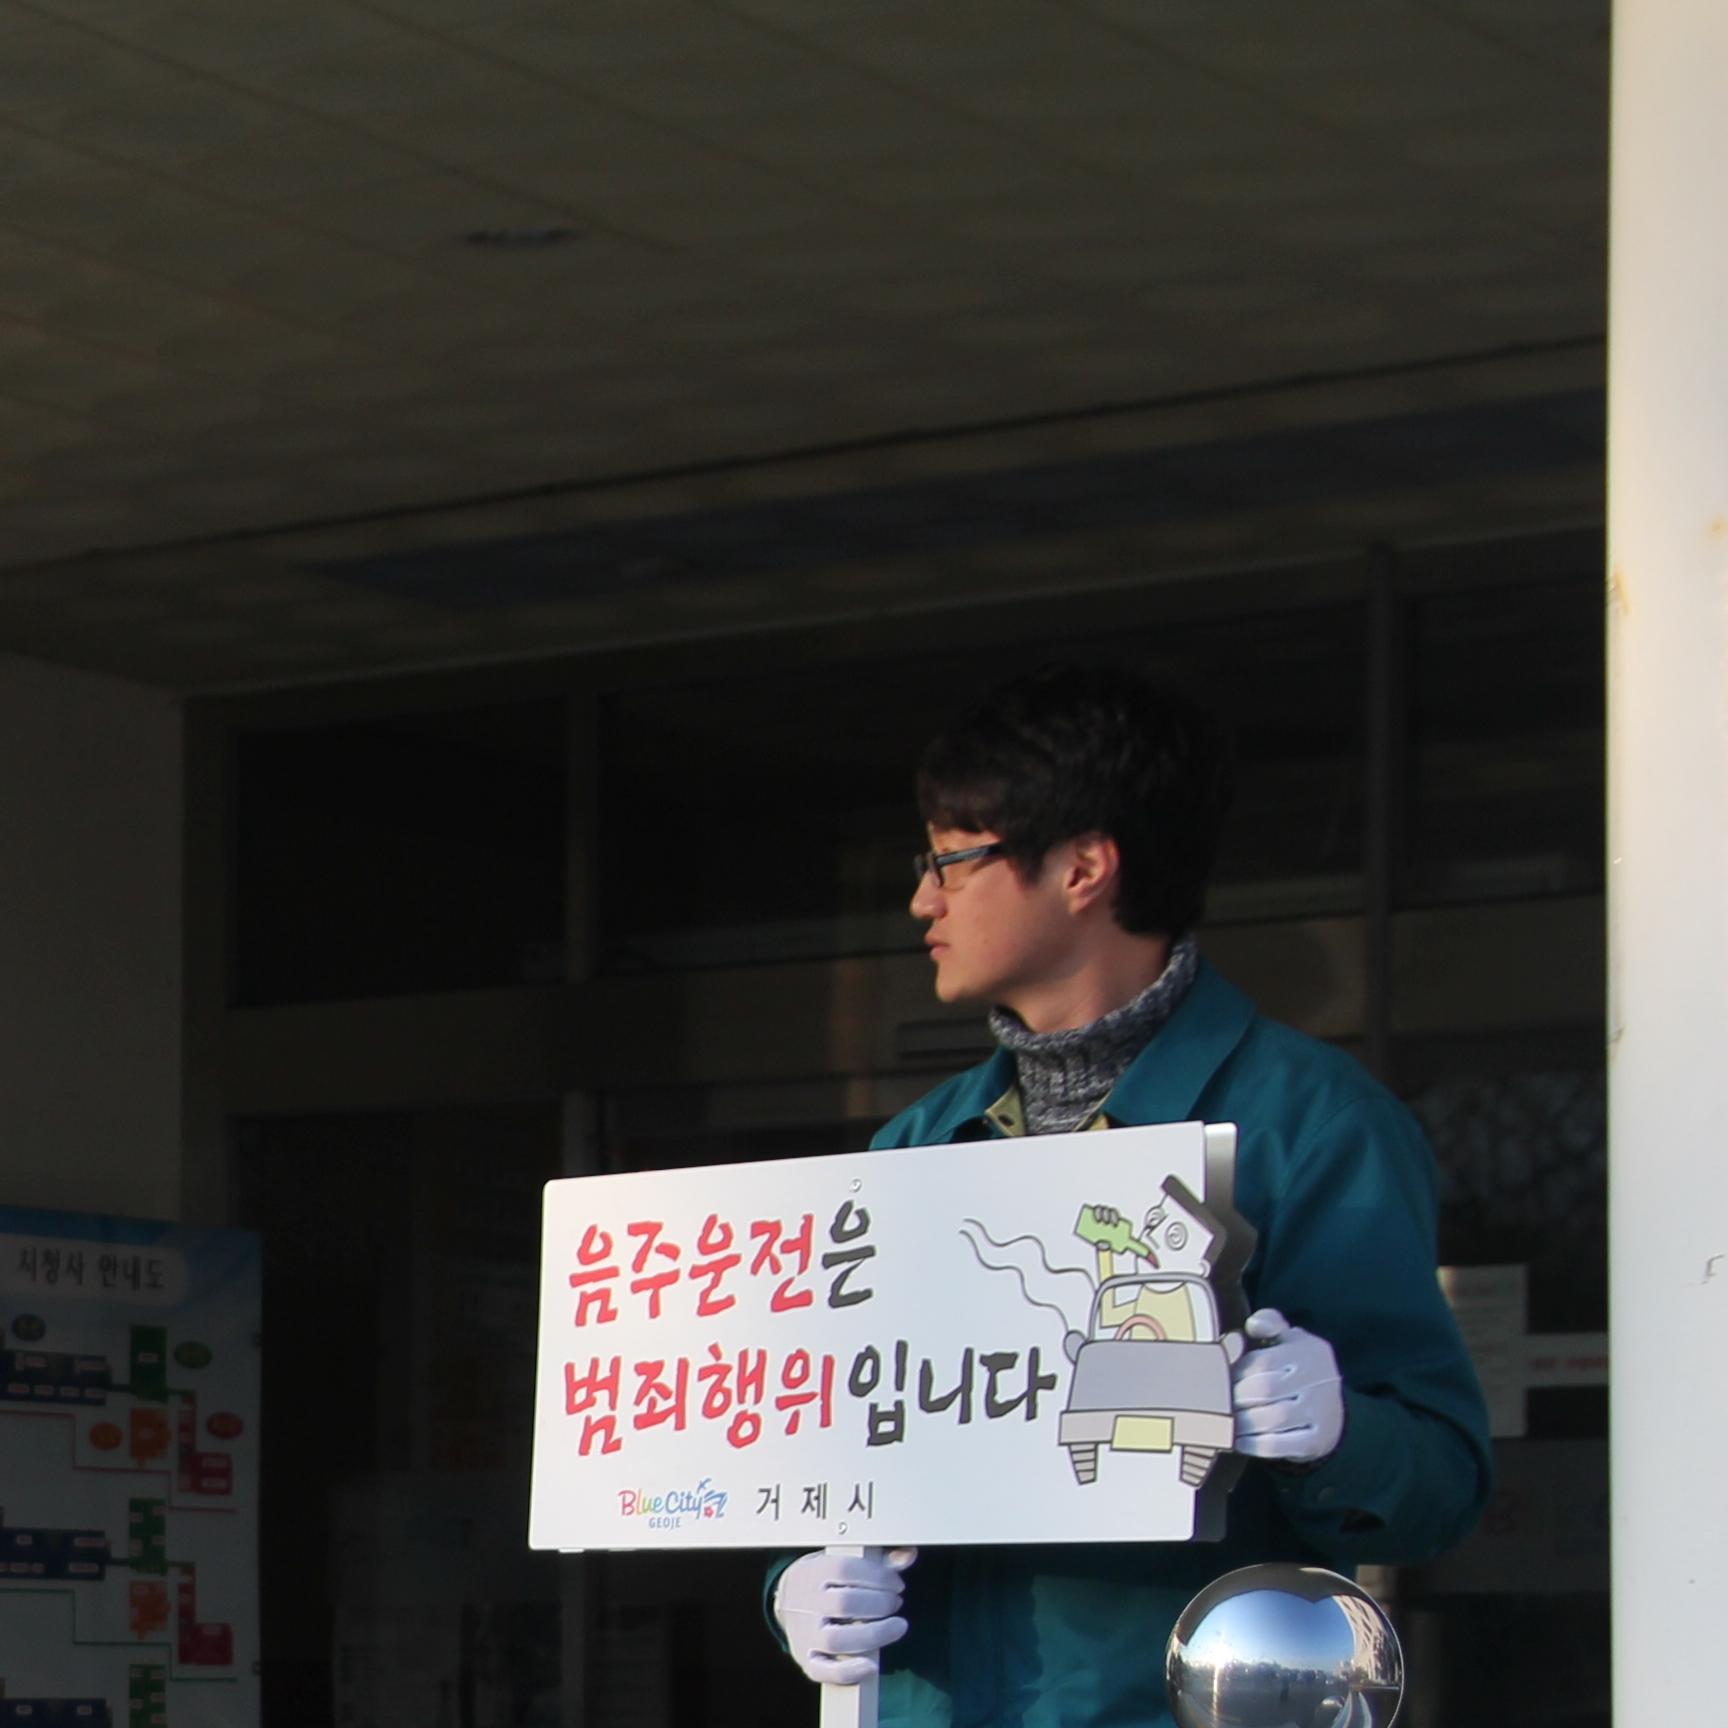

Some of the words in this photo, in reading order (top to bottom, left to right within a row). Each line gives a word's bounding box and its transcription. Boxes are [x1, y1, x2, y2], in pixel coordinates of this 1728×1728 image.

[19, 1245, 85, 1287] 시청사
[98, 1252, 165, 1291] 안내도
[568, 1199, 877, 1328] 음주운전은
[564, 1339, 1058, 1457] 범죄행위입니다
[648, 1516, 682, 1530] GEOJE
